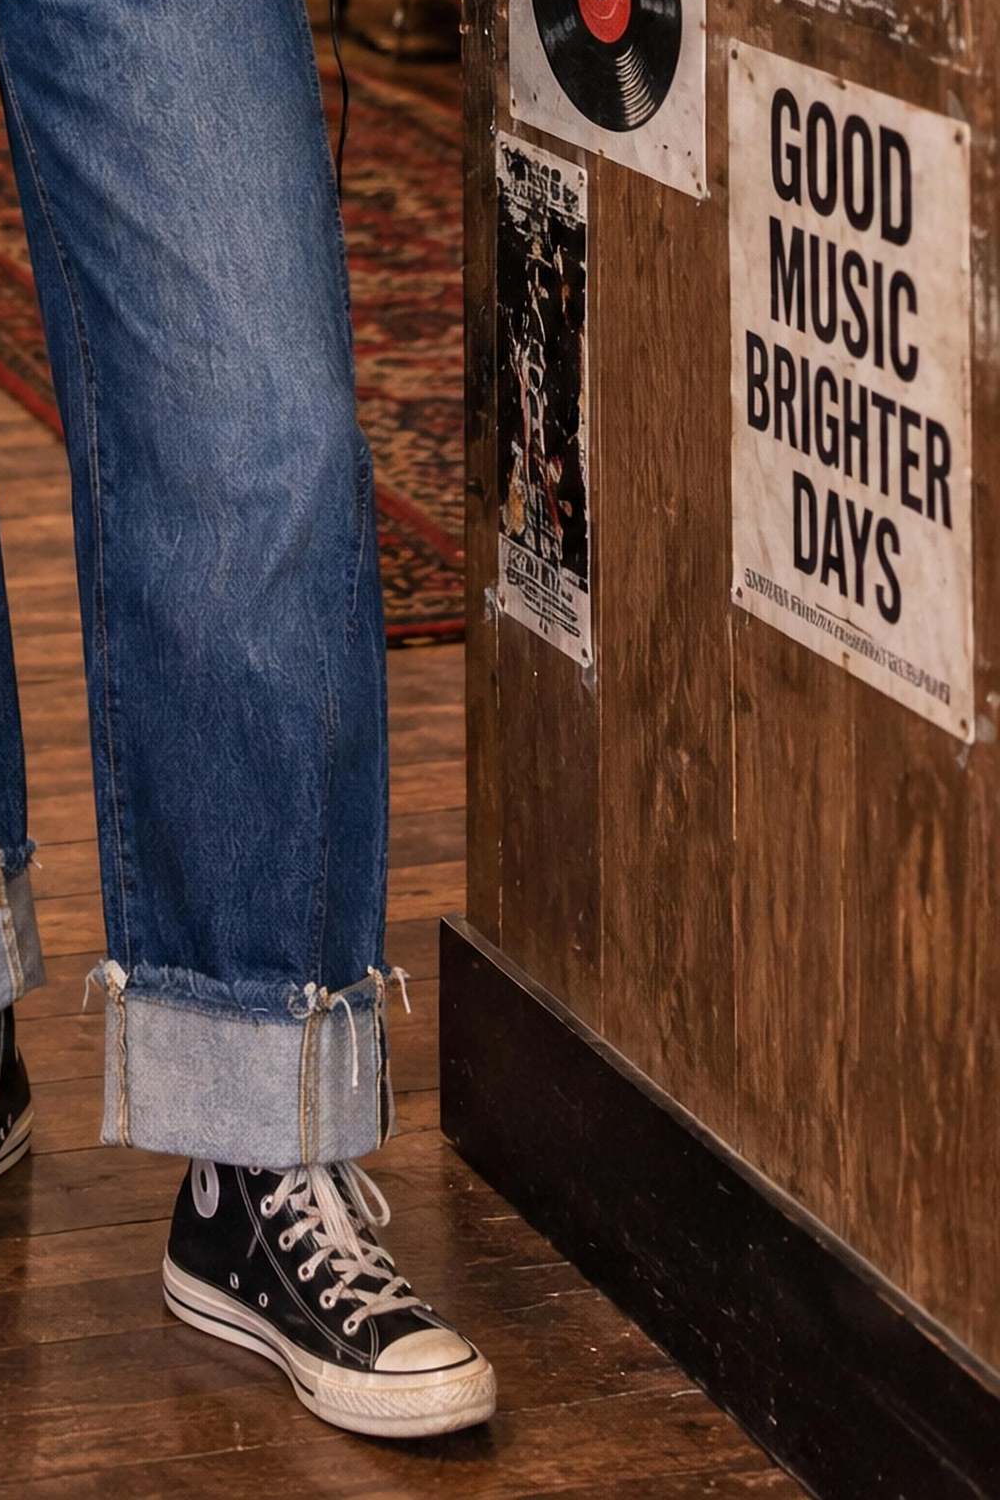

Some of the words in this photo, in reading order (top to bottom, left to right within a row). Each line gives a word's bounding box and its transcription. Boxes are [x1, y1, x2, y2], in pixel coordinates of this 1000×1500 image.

[770, 87, 912, 247] GOOD
[769, 214, 919, 383] MUSIC
[745, 329, 953, 531] BRIGHTER
[792, 469, 902, 625] DAYS
